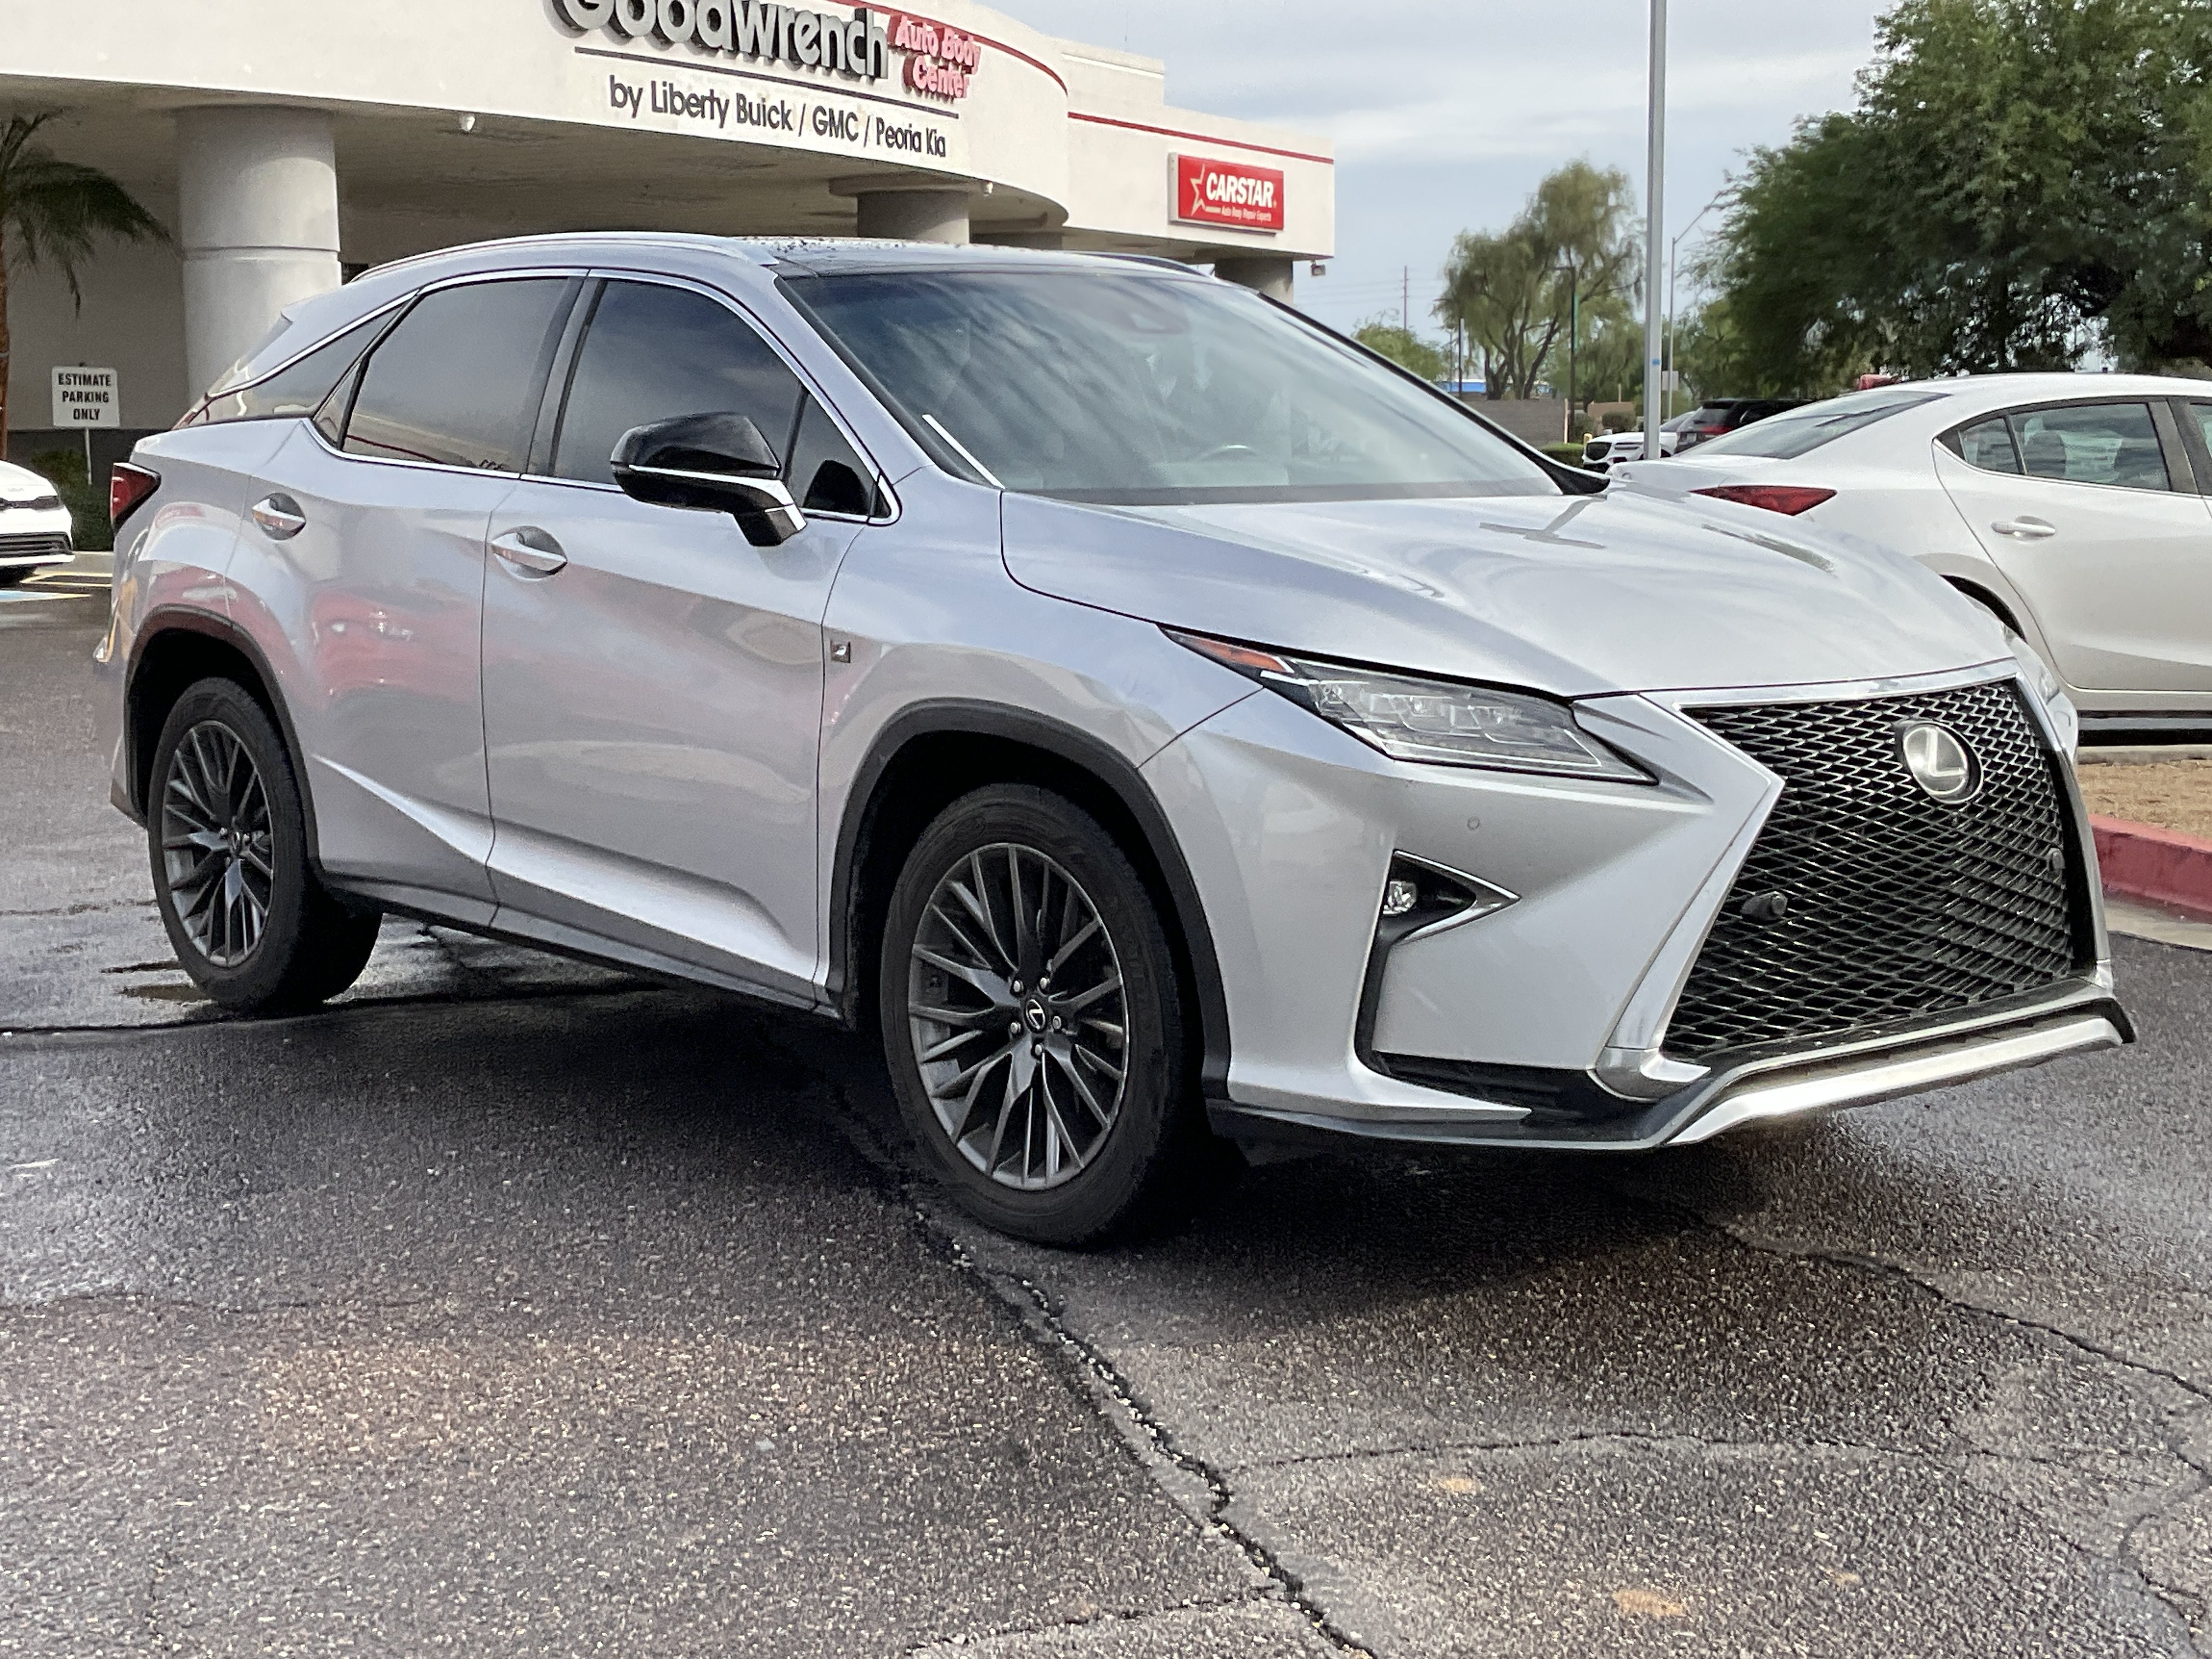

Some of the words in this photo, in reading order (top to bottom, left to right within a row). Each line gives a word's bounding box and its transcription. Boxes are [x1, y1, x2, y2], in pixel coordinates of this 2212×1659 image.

[894, 15, 939, 58] Auto
[941, 28, 981, 75] Body
[912, 55, 970, 99] Center
[610, 74, 643, 119] by
[651, 80, 730, 128] Liberty
[736, 92, 793, 131] Buick
[812, 105, 859, 142] GMC
[876, 116, 922, 153] Peoria
[926, 127, 946, 157] Kia
[1206, 172, 1274, 208] CARSTAR
[58, 373, 111, 386] ESTIMATE
[62, 390, 109, 403] PARKING
[73, 408, 100, 420] ONLY
